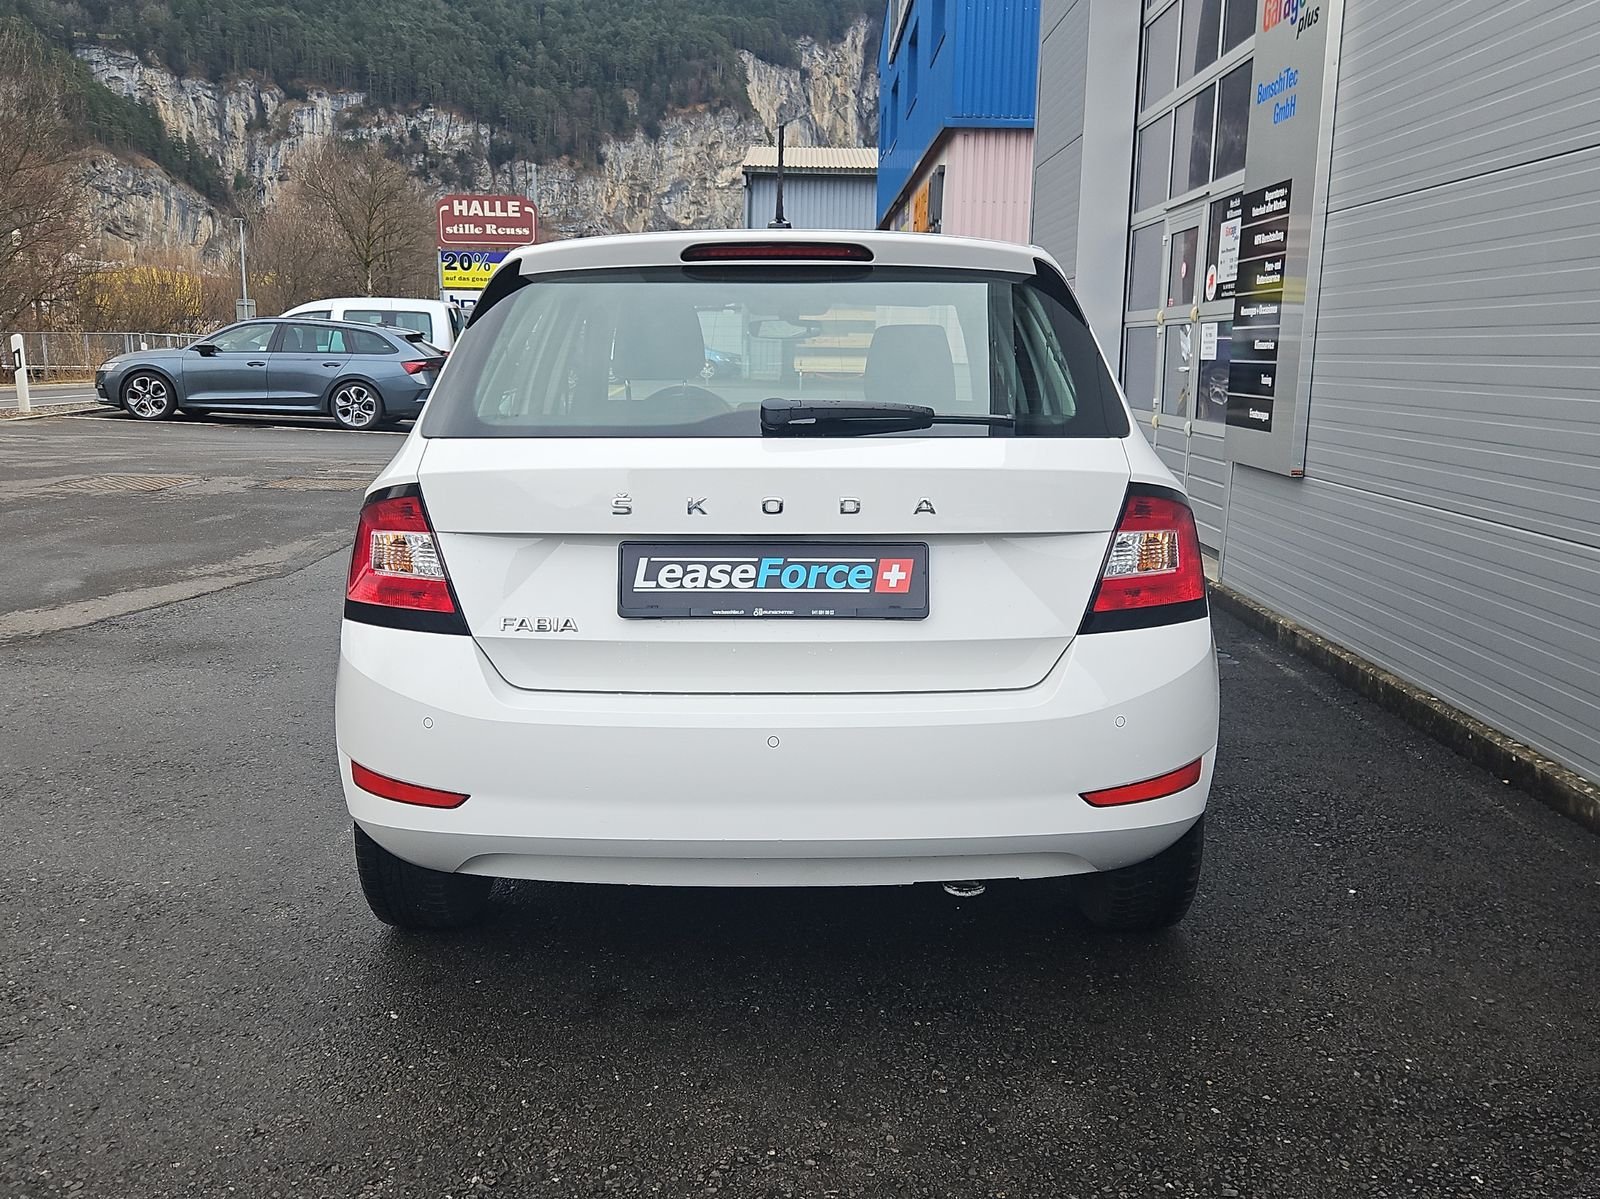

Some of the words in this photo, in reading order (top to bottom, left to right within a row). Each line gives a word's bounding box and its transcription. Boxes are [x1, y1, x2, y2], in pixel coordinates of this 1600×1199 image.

[1296, 6, 1320, 40] plus
[1257, 67, 1298, 104] BunschiTec
[1273, 94, 1296, 125] GmbH
[453, 200, 521, 217] HALLE
[445, 224, 483, 235] stille
[485, 224, 530, 235] Reuss
[443, 252, 491, 272] 20%
[633, 557, 874, 590] LeaseForce
[498, 617, 580, 633] FABIA
